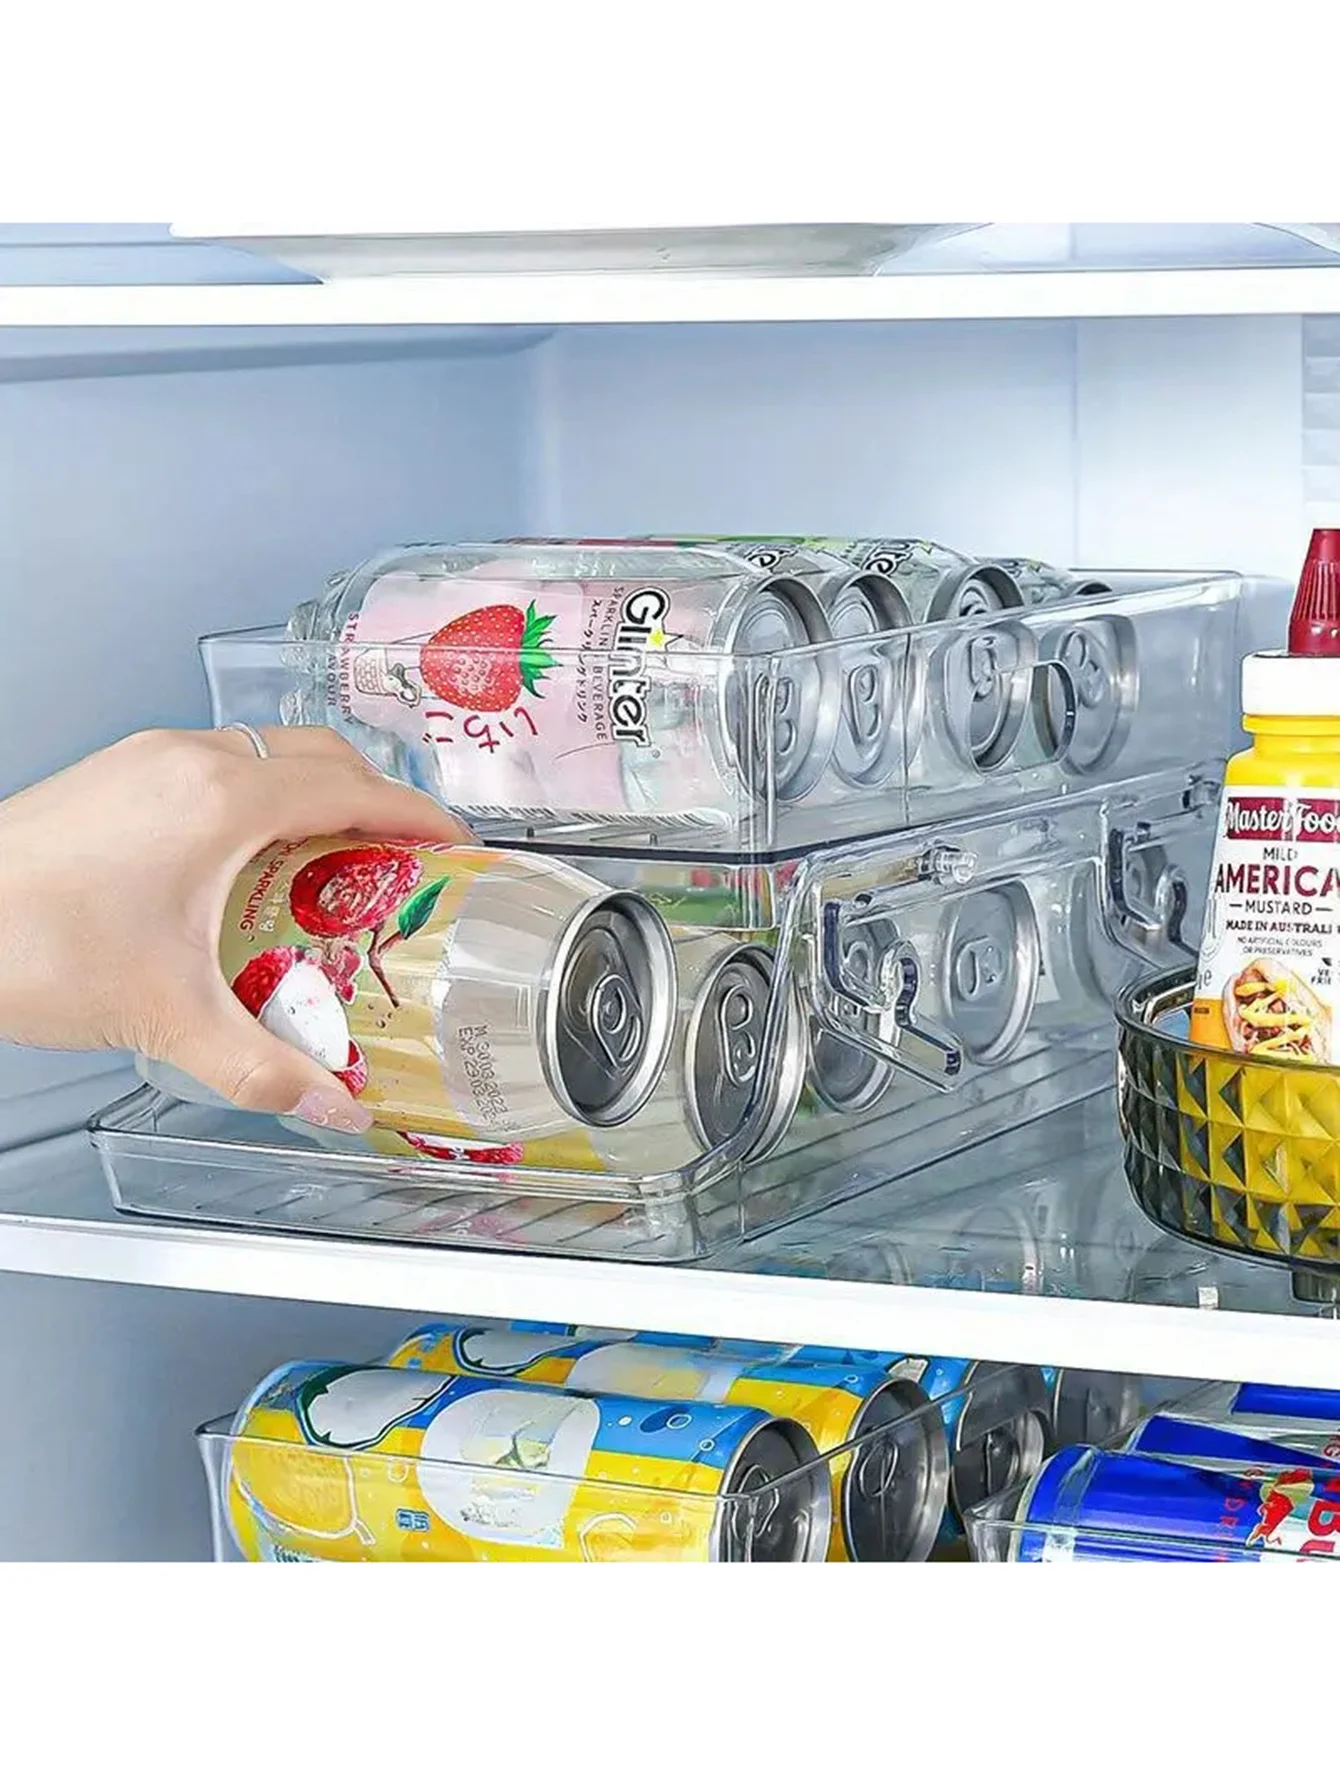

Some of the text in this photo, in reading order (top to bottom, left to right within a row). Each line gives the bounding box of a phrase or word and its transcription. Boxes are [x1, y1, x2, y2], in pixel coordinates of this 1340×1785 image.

[338, 613, 360, 724] STRAWBERRY
[591, 586, 624, 741] SPARKLIN BEVERAGE
[611, 588, 667, 746] Glinter
[1262, 846, 1298, 861] MILD
[239, 859, 285, 931] SPARKLING
[1226, 920, 1253, 931] MADE
[1254, 921, 1269, 932] IN
[1245, 899, 1313, 916] MUSTARD
